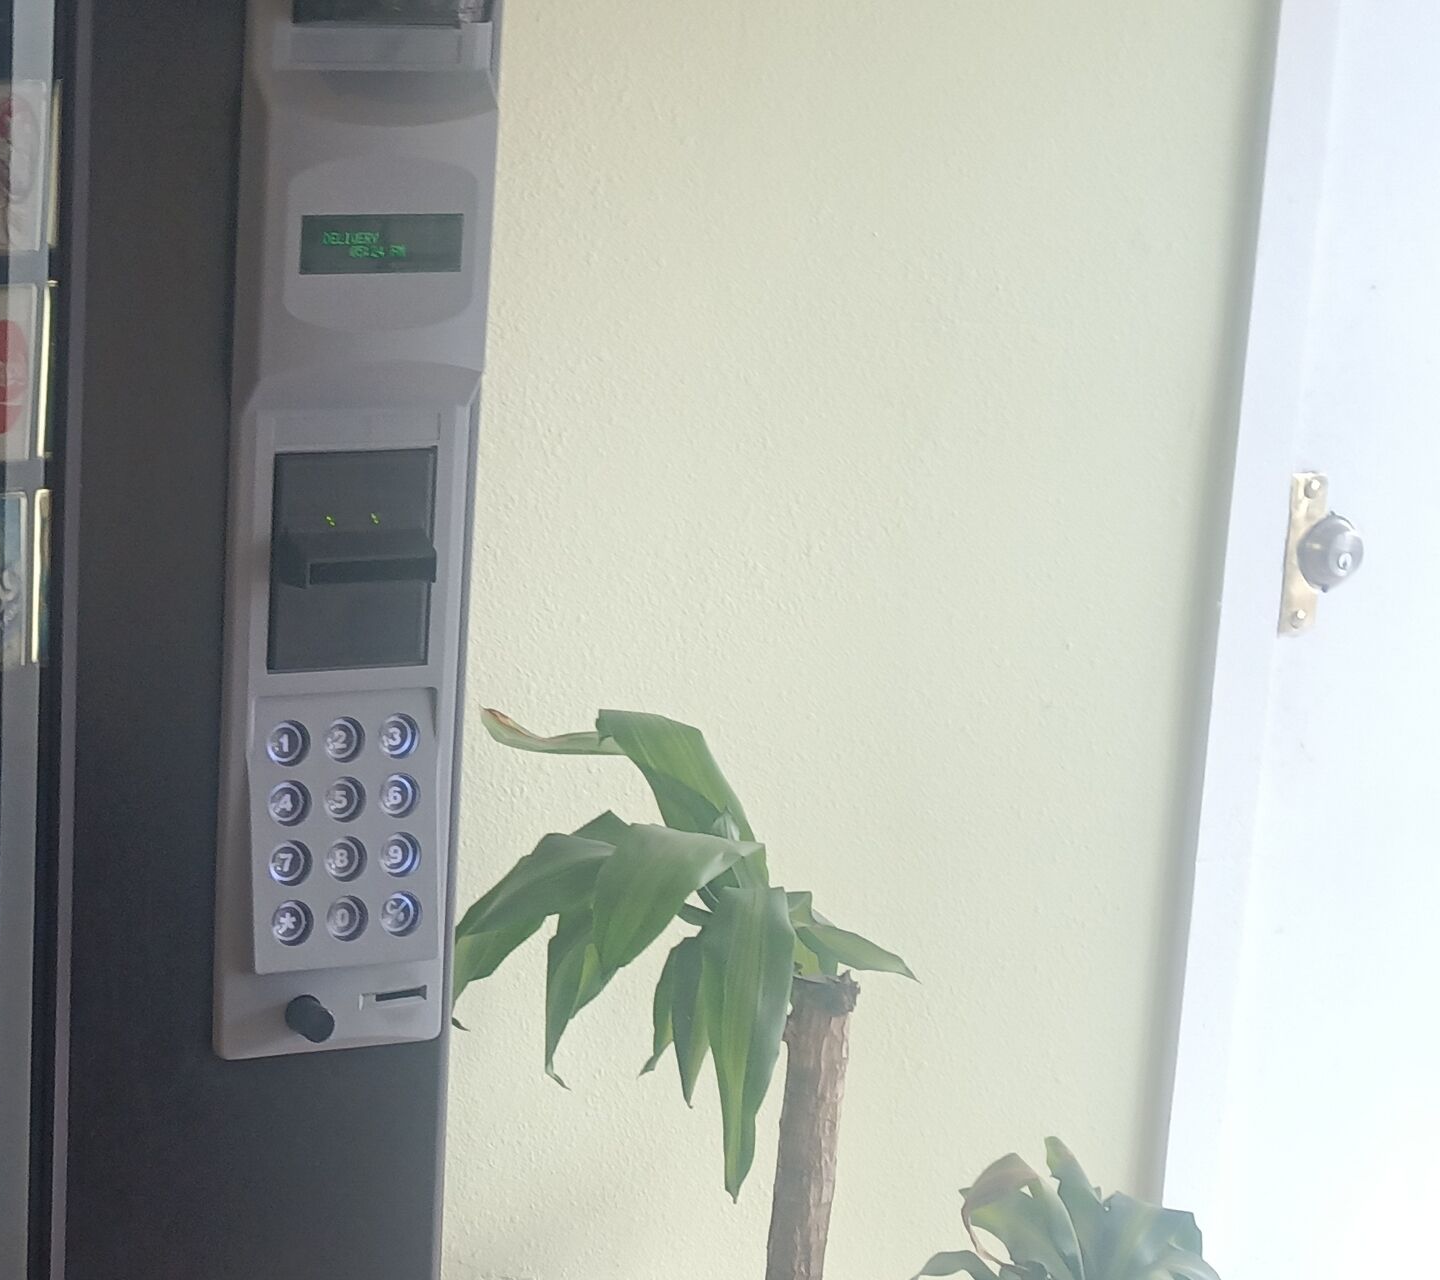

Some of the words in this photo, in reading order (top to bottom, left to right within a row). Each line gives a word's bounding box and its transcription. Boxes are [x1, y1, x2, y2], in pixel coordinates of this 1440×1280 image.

[279, 734, 289, 752] 1
[332, 730, 347, 748] 2
[388, 727, 401, 746] 3
[279, 793, 293, 811] 4
[334, 790, 348, 809] 5
[387, 786, 402, 805] 6
[279, 853, 293, 872] 7
[335, 849, 348, 868] 8
[388, 845, 402, 864] 9
